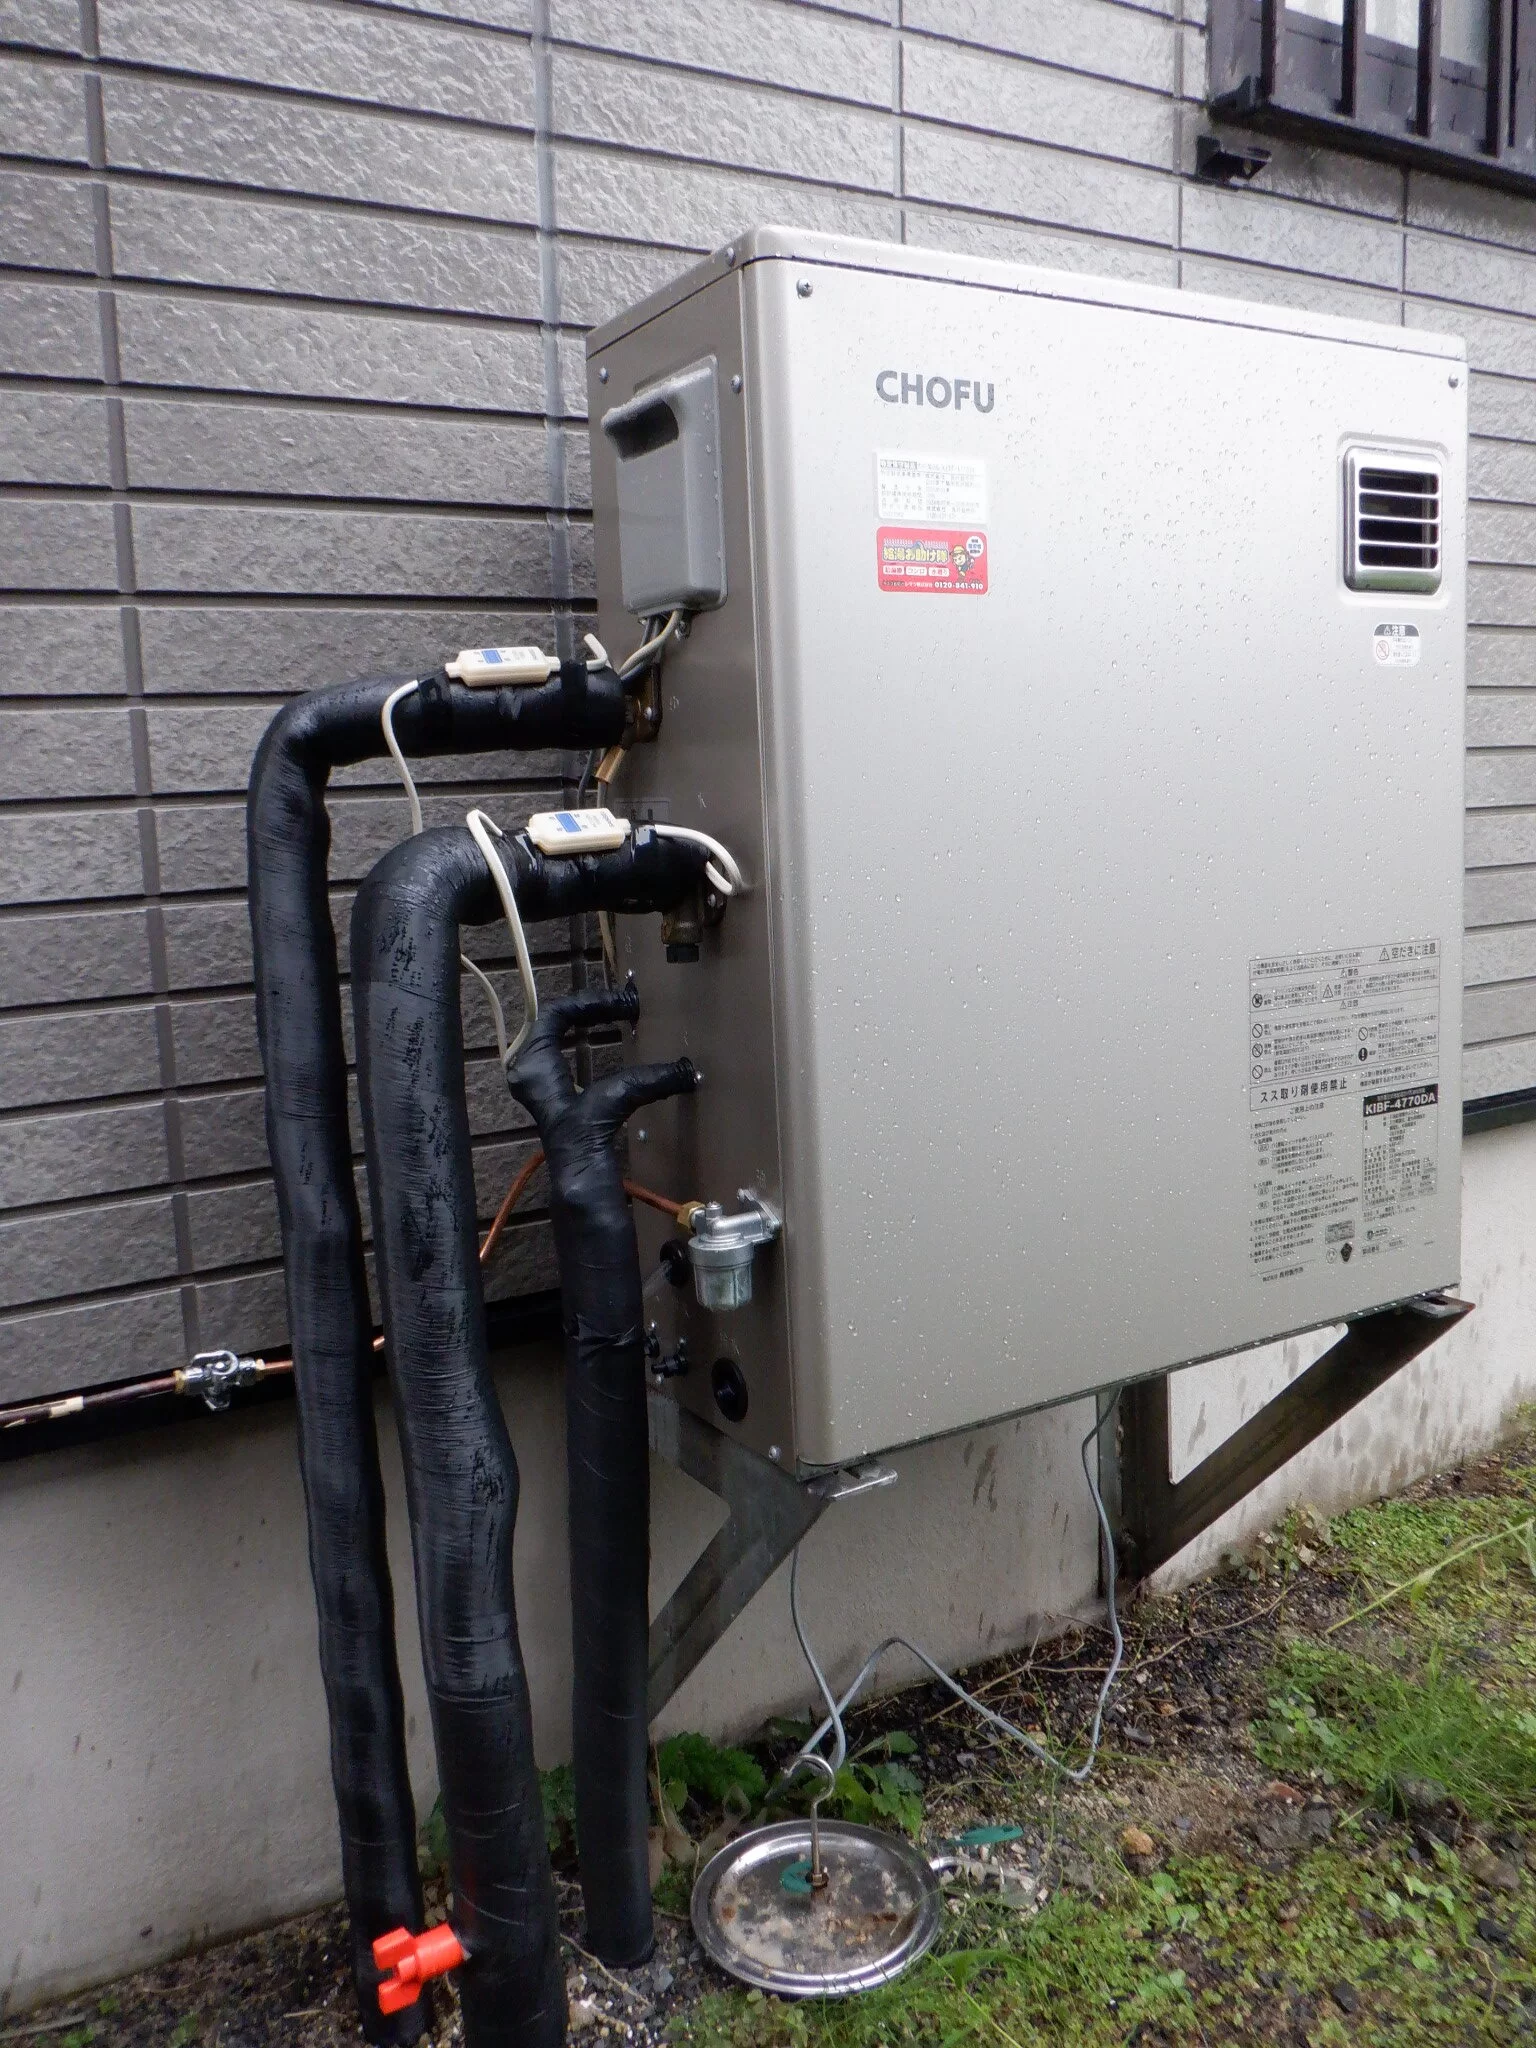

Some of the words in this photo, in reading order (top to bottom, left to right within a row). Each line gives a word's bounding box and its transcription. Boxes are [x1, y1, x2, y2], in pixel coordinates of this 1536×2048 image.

[875, 370, 995, 414] CHOFU
[883, 546, 949, 563] 給湯お助け隊
[1391, 943, 1437, 959] 空だきに注意
[1260, 1077, 1348, 1103] スス取り剤使用禁止
[1365, 1092, 1436, 1115] KIBF-4770DA
